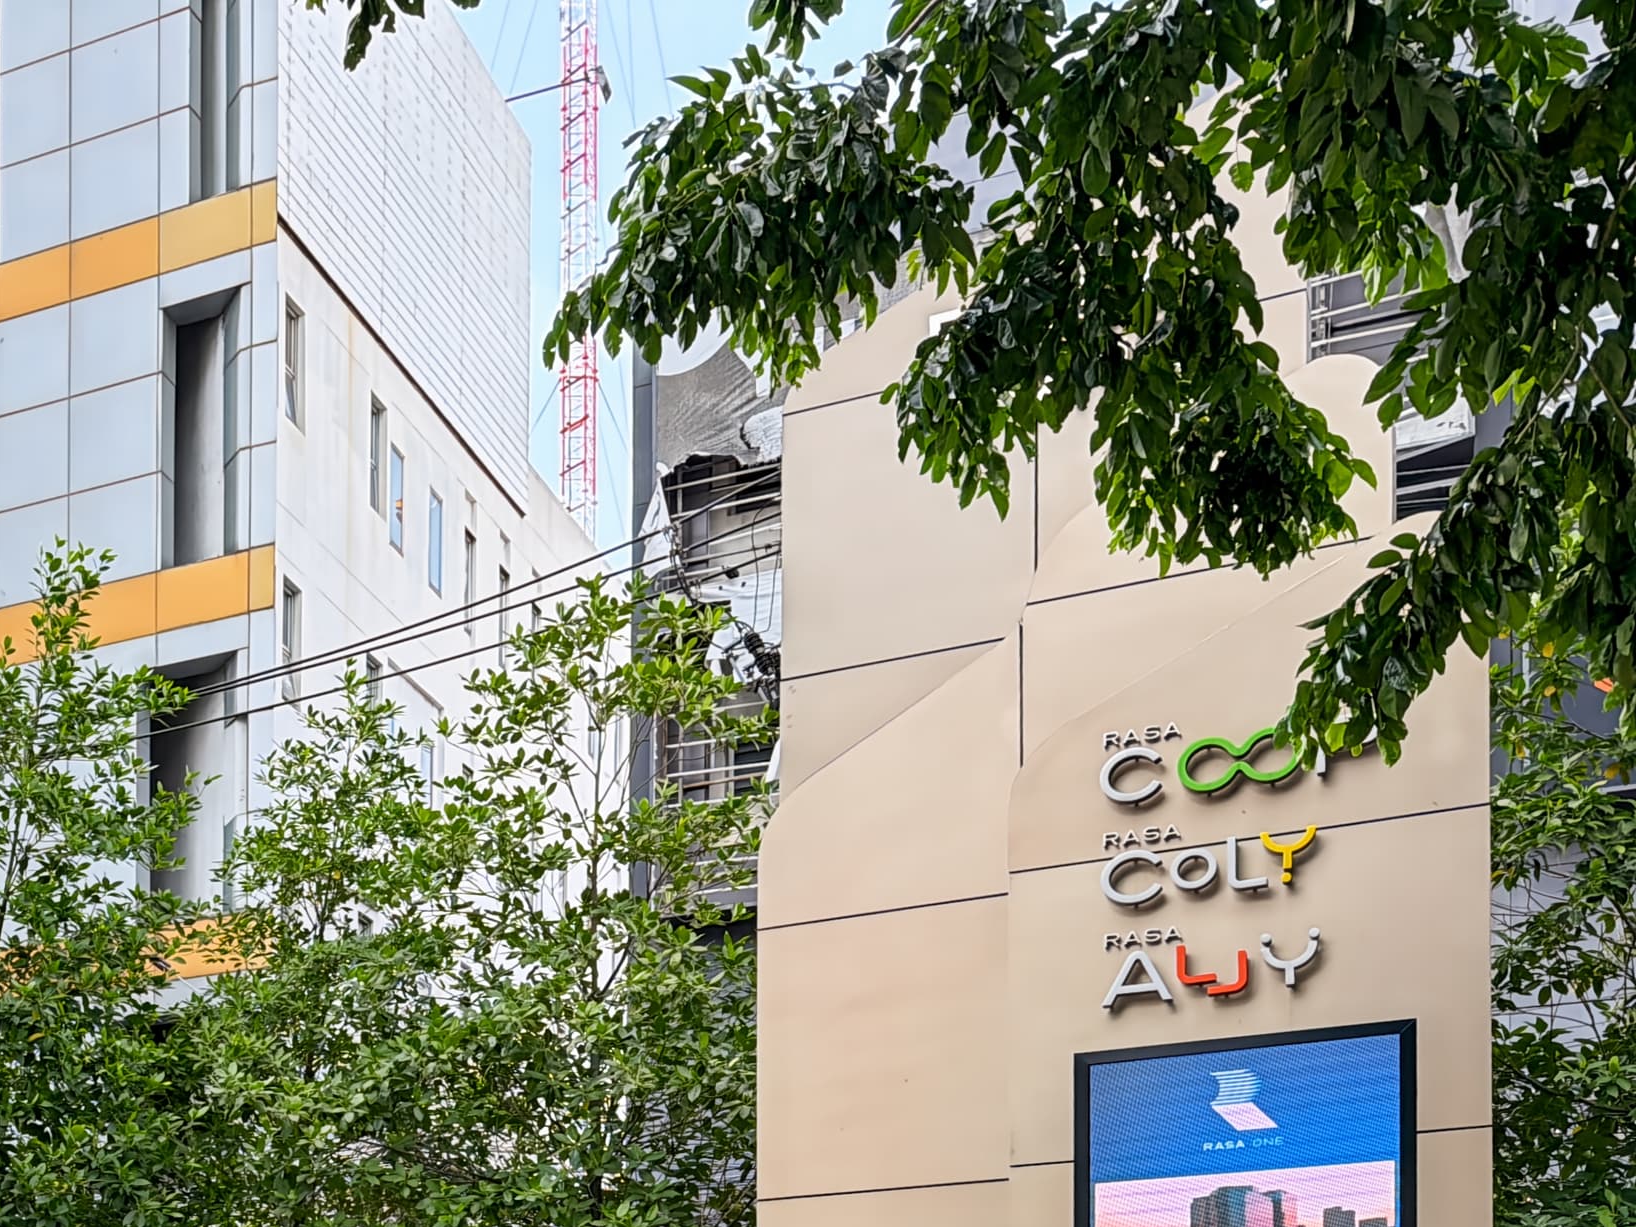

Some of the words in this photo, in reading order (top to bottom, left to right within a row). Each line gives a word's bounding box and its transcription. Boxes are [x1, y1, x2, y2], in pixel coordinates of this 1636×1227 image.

[1102, 721, 1182, 750] RASA
[1102, 824, 1181, 850] RASA
[1100, 824, 1317, 906] COLY
[1104, 926, 1183, 950] RASA
[1202, 1140, 1245, 1152] RASA
[1252, 1136, 1285, 1148] ONE
